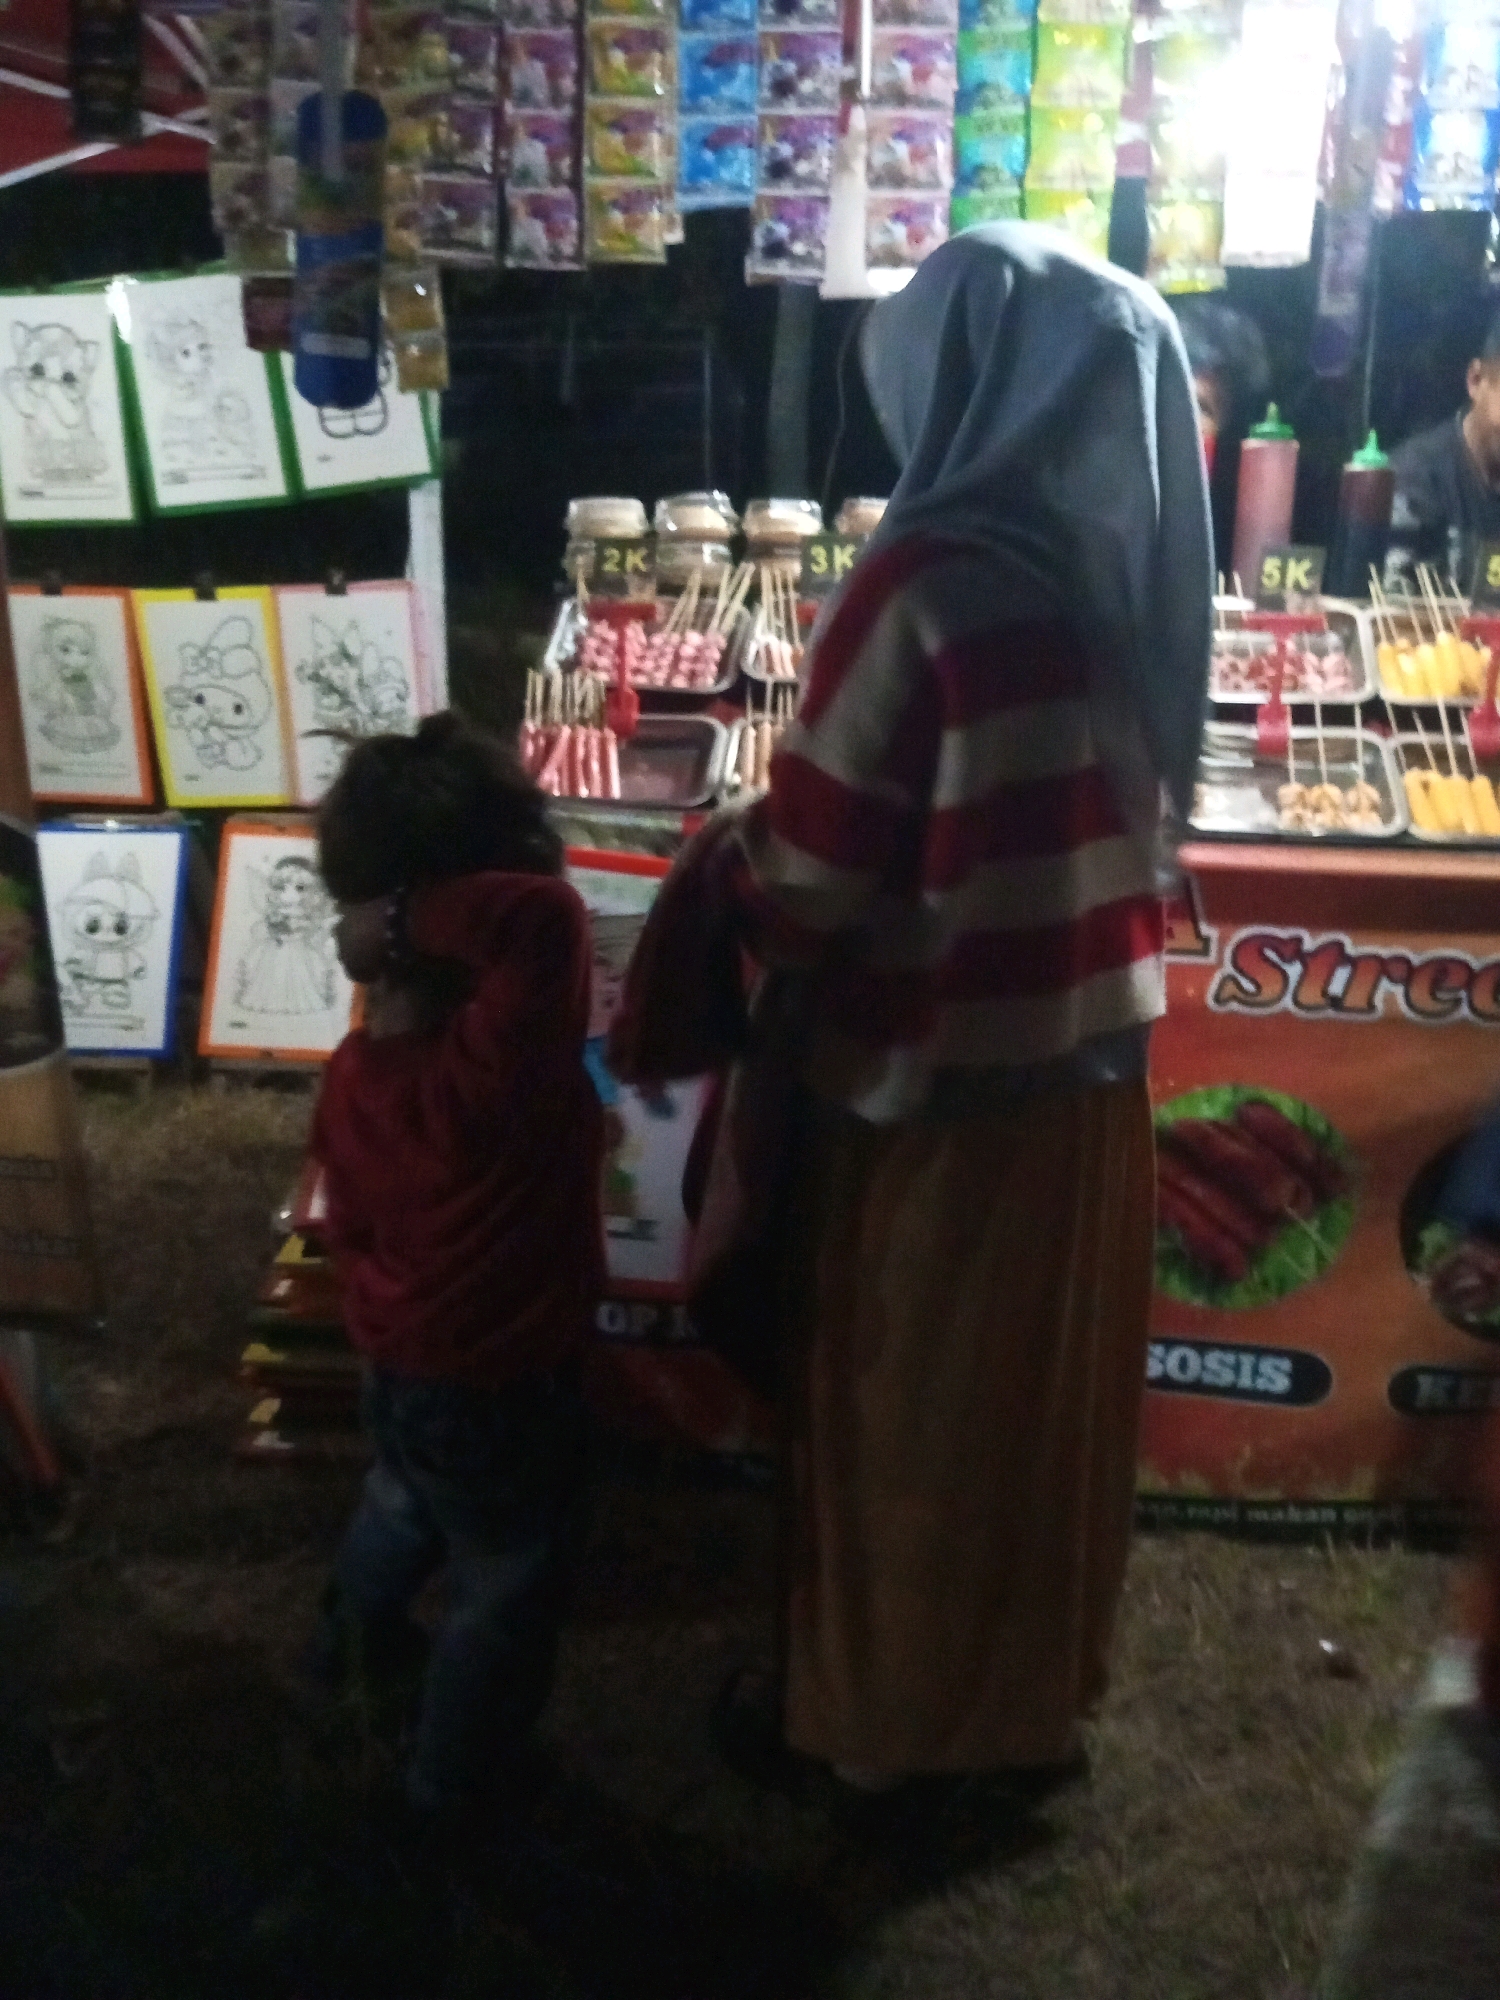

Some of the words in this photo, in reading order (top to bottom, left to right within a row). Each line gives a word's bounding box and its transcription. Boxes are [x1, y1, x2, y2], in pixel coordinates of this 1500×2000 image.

[602, 546, 649, 573] 2K
[810, 543, 858, 574] 3K
[1261, 554, 1312, 591] 5K
